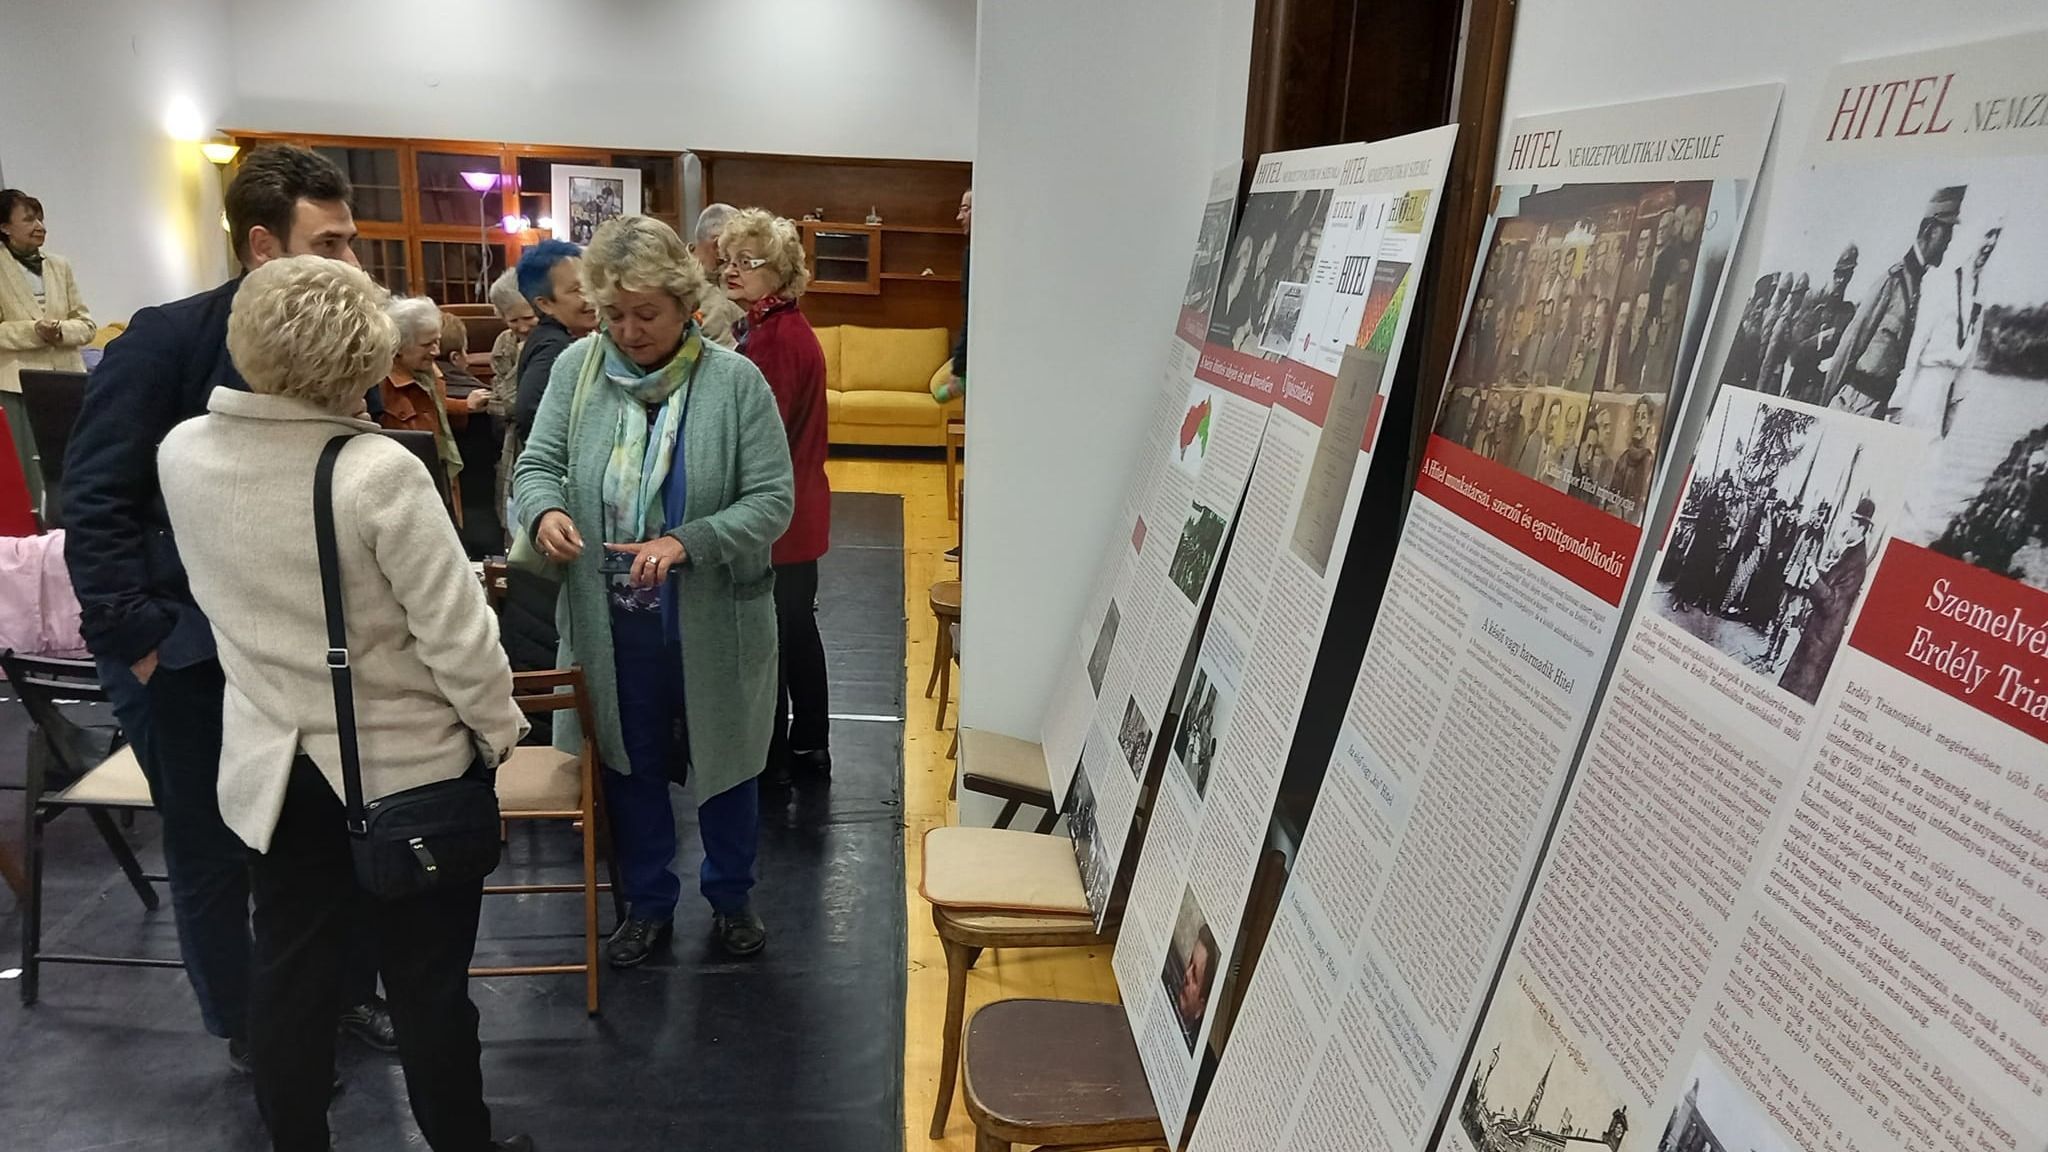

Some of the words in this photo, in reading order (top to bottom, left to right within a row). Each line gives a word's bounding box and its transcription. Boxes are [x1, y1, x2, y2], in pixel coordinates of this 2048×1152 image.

[1826, 73, 1956, 142] HITEL
[1341, 156, 1368, 186] HITEL
[1508, 129, 1563, 171] HITEL
[1566, 140, 1667, 168] NEMZETPOLITIKAI
[1666, 134, 1725, 160] SZEMLE
[1256, 161, 1283, 185] HITEL
[1336, 255, 1371, 297] HITEL
[1421, 457, 1431, 475] A
[1429, 459, 1448, 485] Hitel
[1444, 473, 1492, 510] munkatársai,
[1491, 496, 1522, 525] szerzői
[1520, 508, 1532, 530] és
[1531, 519, 1626, 578] együttgondolkodói
[1503, 636, 1521, 658] vagy
[1518, 644, 1555, 678] harmadik
[1552, 670, 1574, 693] Hitel
[1905, 625, 1992, 694] Erdély
[1846, 681, 1872, 706] Erdély
[1875, 697, 1933, 736] Trianonjának
[1936, 733, 2002, 774] megértésében
[2006, 769, 2031, 789] több
[1889, 747, 1911, 770] hogy
[1921, 768, 1971, 806] magyarság
[1906, 802, 1927, 819] után
[1928, 813, 1987, 858] intézményes
[1988, 850, 2021, 879] háttér
[1924, 791, 1960, 816] unióval
[1972, 820, 2029, 863] anyaország
[1895, 834, 1929, 866] Erdélyt
[1929, 861, 1956, 882] sújtó
[1902, 887, 1935, 915] erdélyi
[1934, 884, 1959, 908] által
[1863, 946, 1900, 979] váratlan
[1940, 937, 1968, 966] addig
[1885, 985, 1904, 1003] mai
[1951, 993, 1974, 1015] nem
[1974, 1011, 2000, 1035] csak
[1930, 1064, 1966, 1103] Balkán
